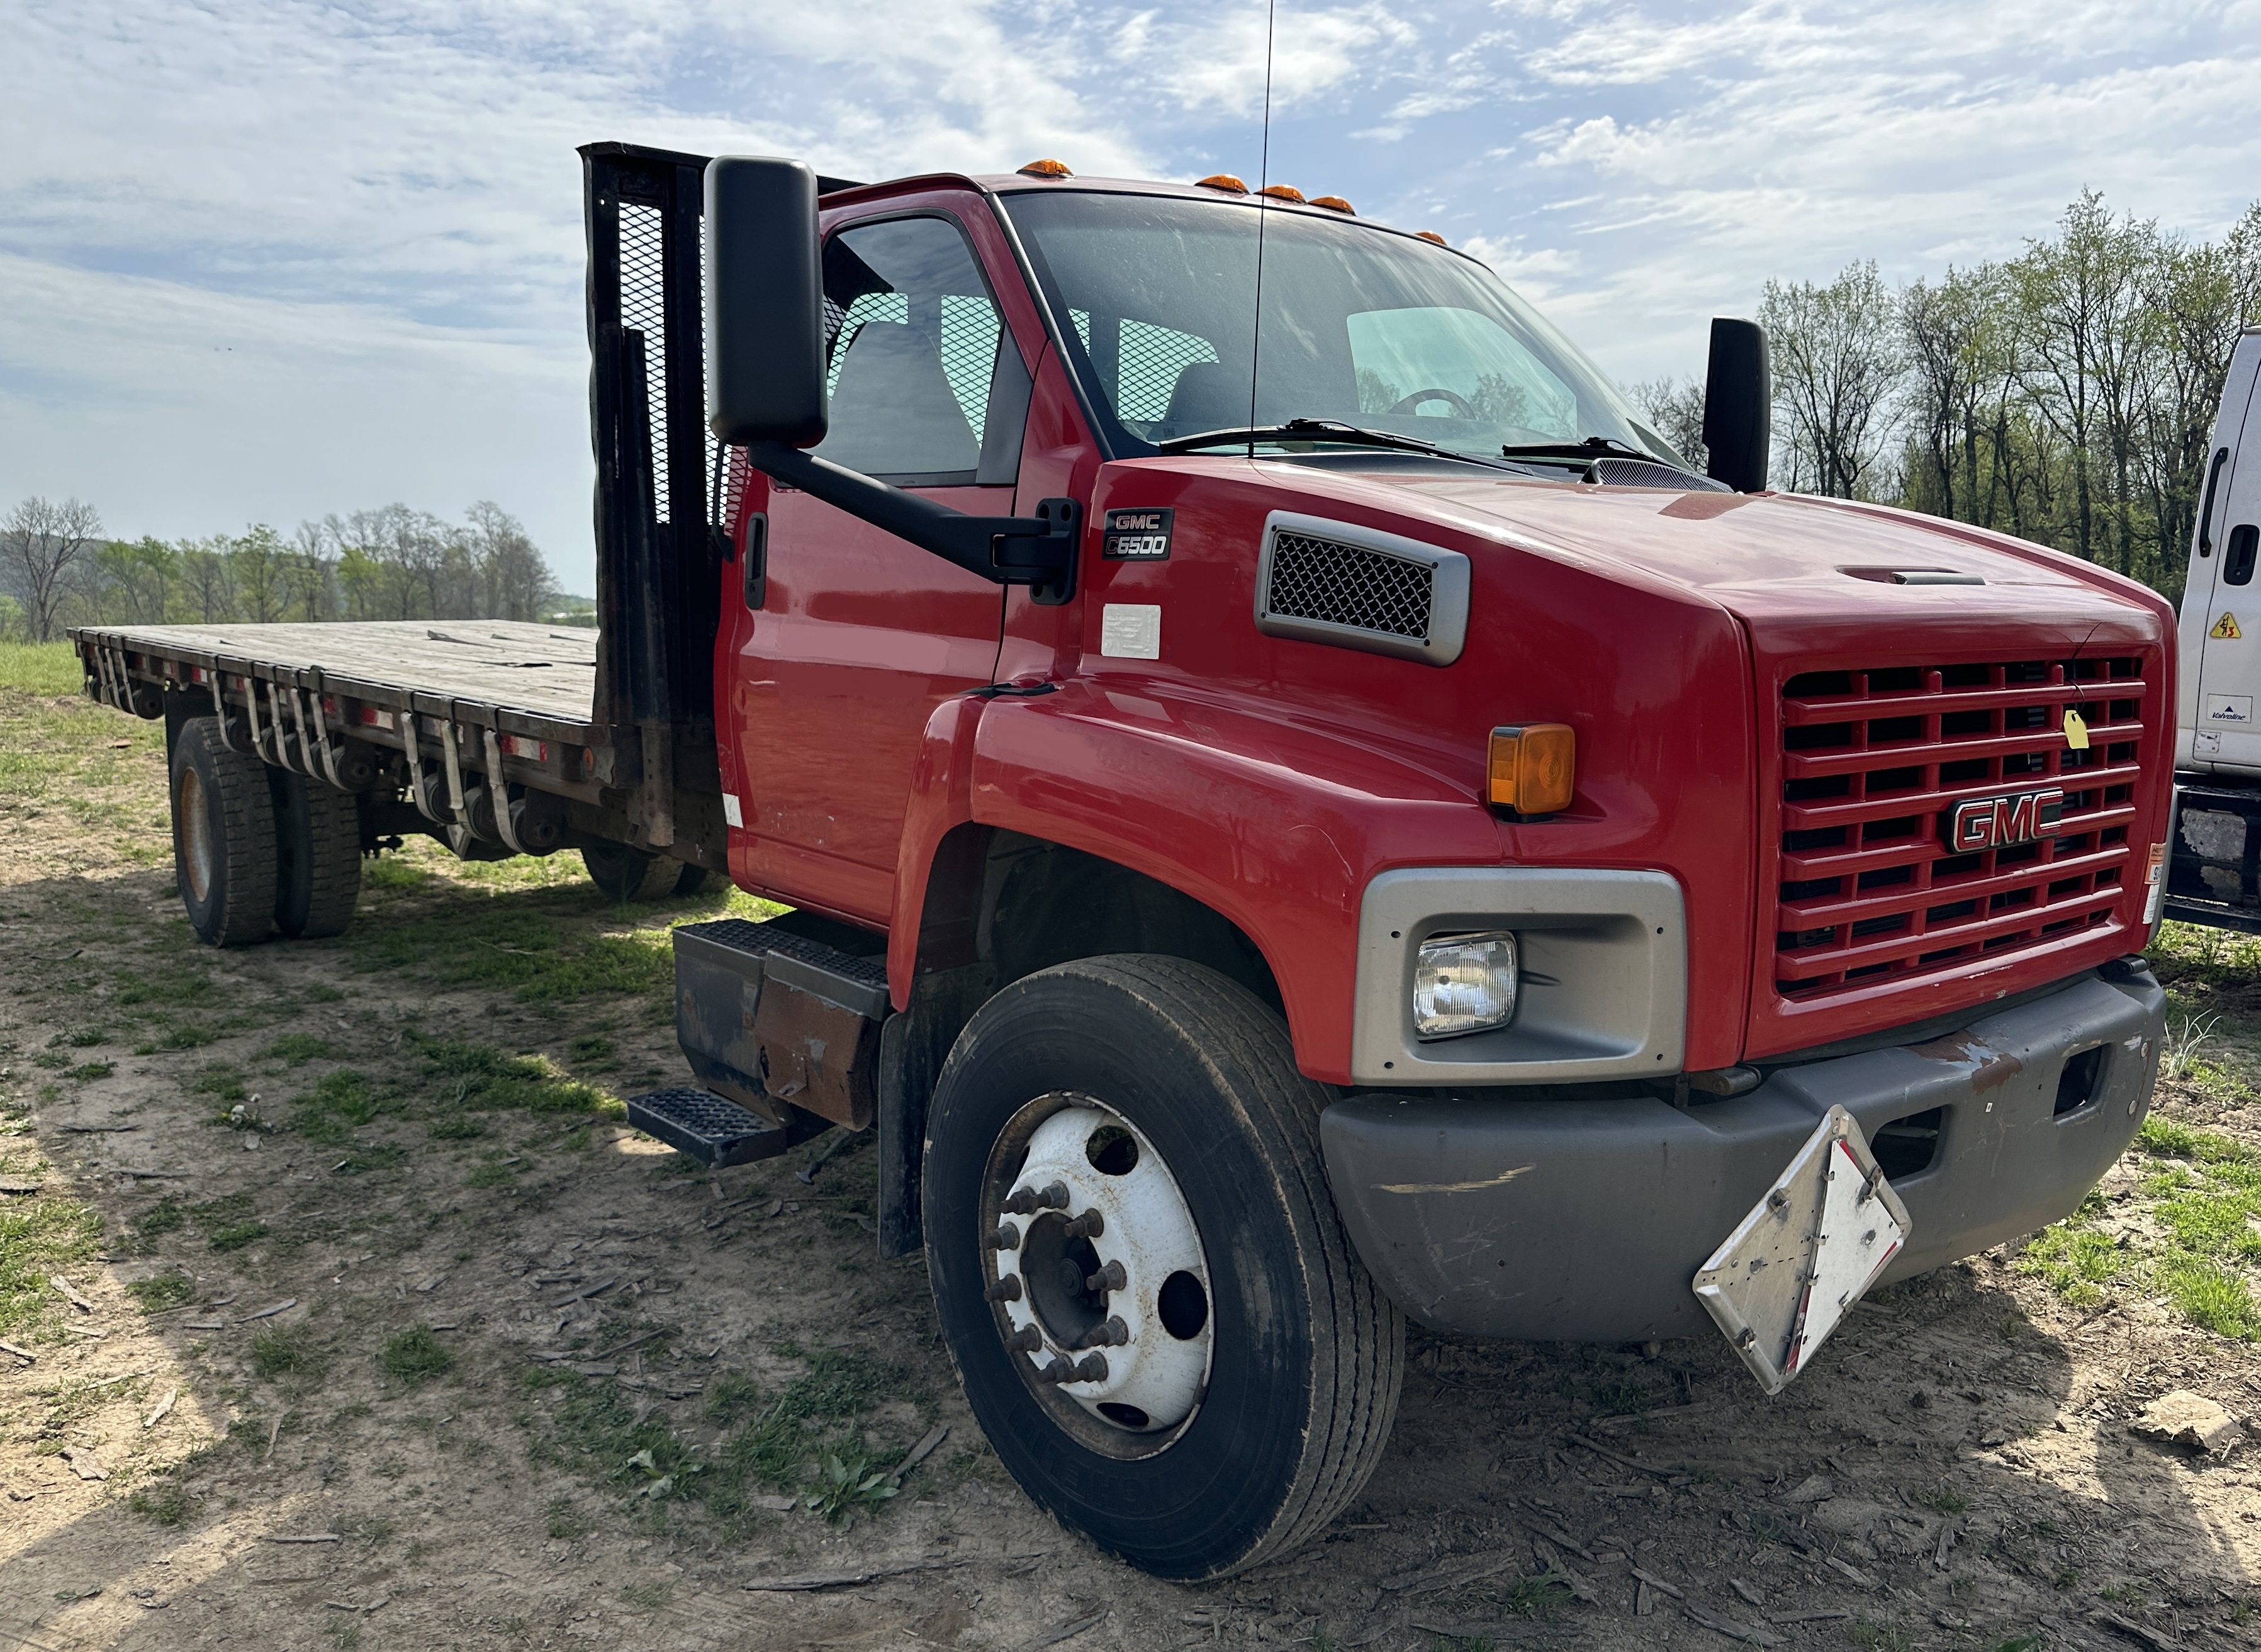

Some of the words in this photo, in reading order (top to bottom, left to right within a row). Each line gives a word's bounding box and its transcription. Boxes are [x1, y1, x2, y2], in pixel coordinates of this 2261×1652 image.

[1116, 515, 1160, 529] GMC
[1106, 536, 1167, 554] C6500
[2228, 627, 2235, 638] 3
[2212, 712, 2246, 721] Valvoline
[1954, 790, 2064, 853] GMC
